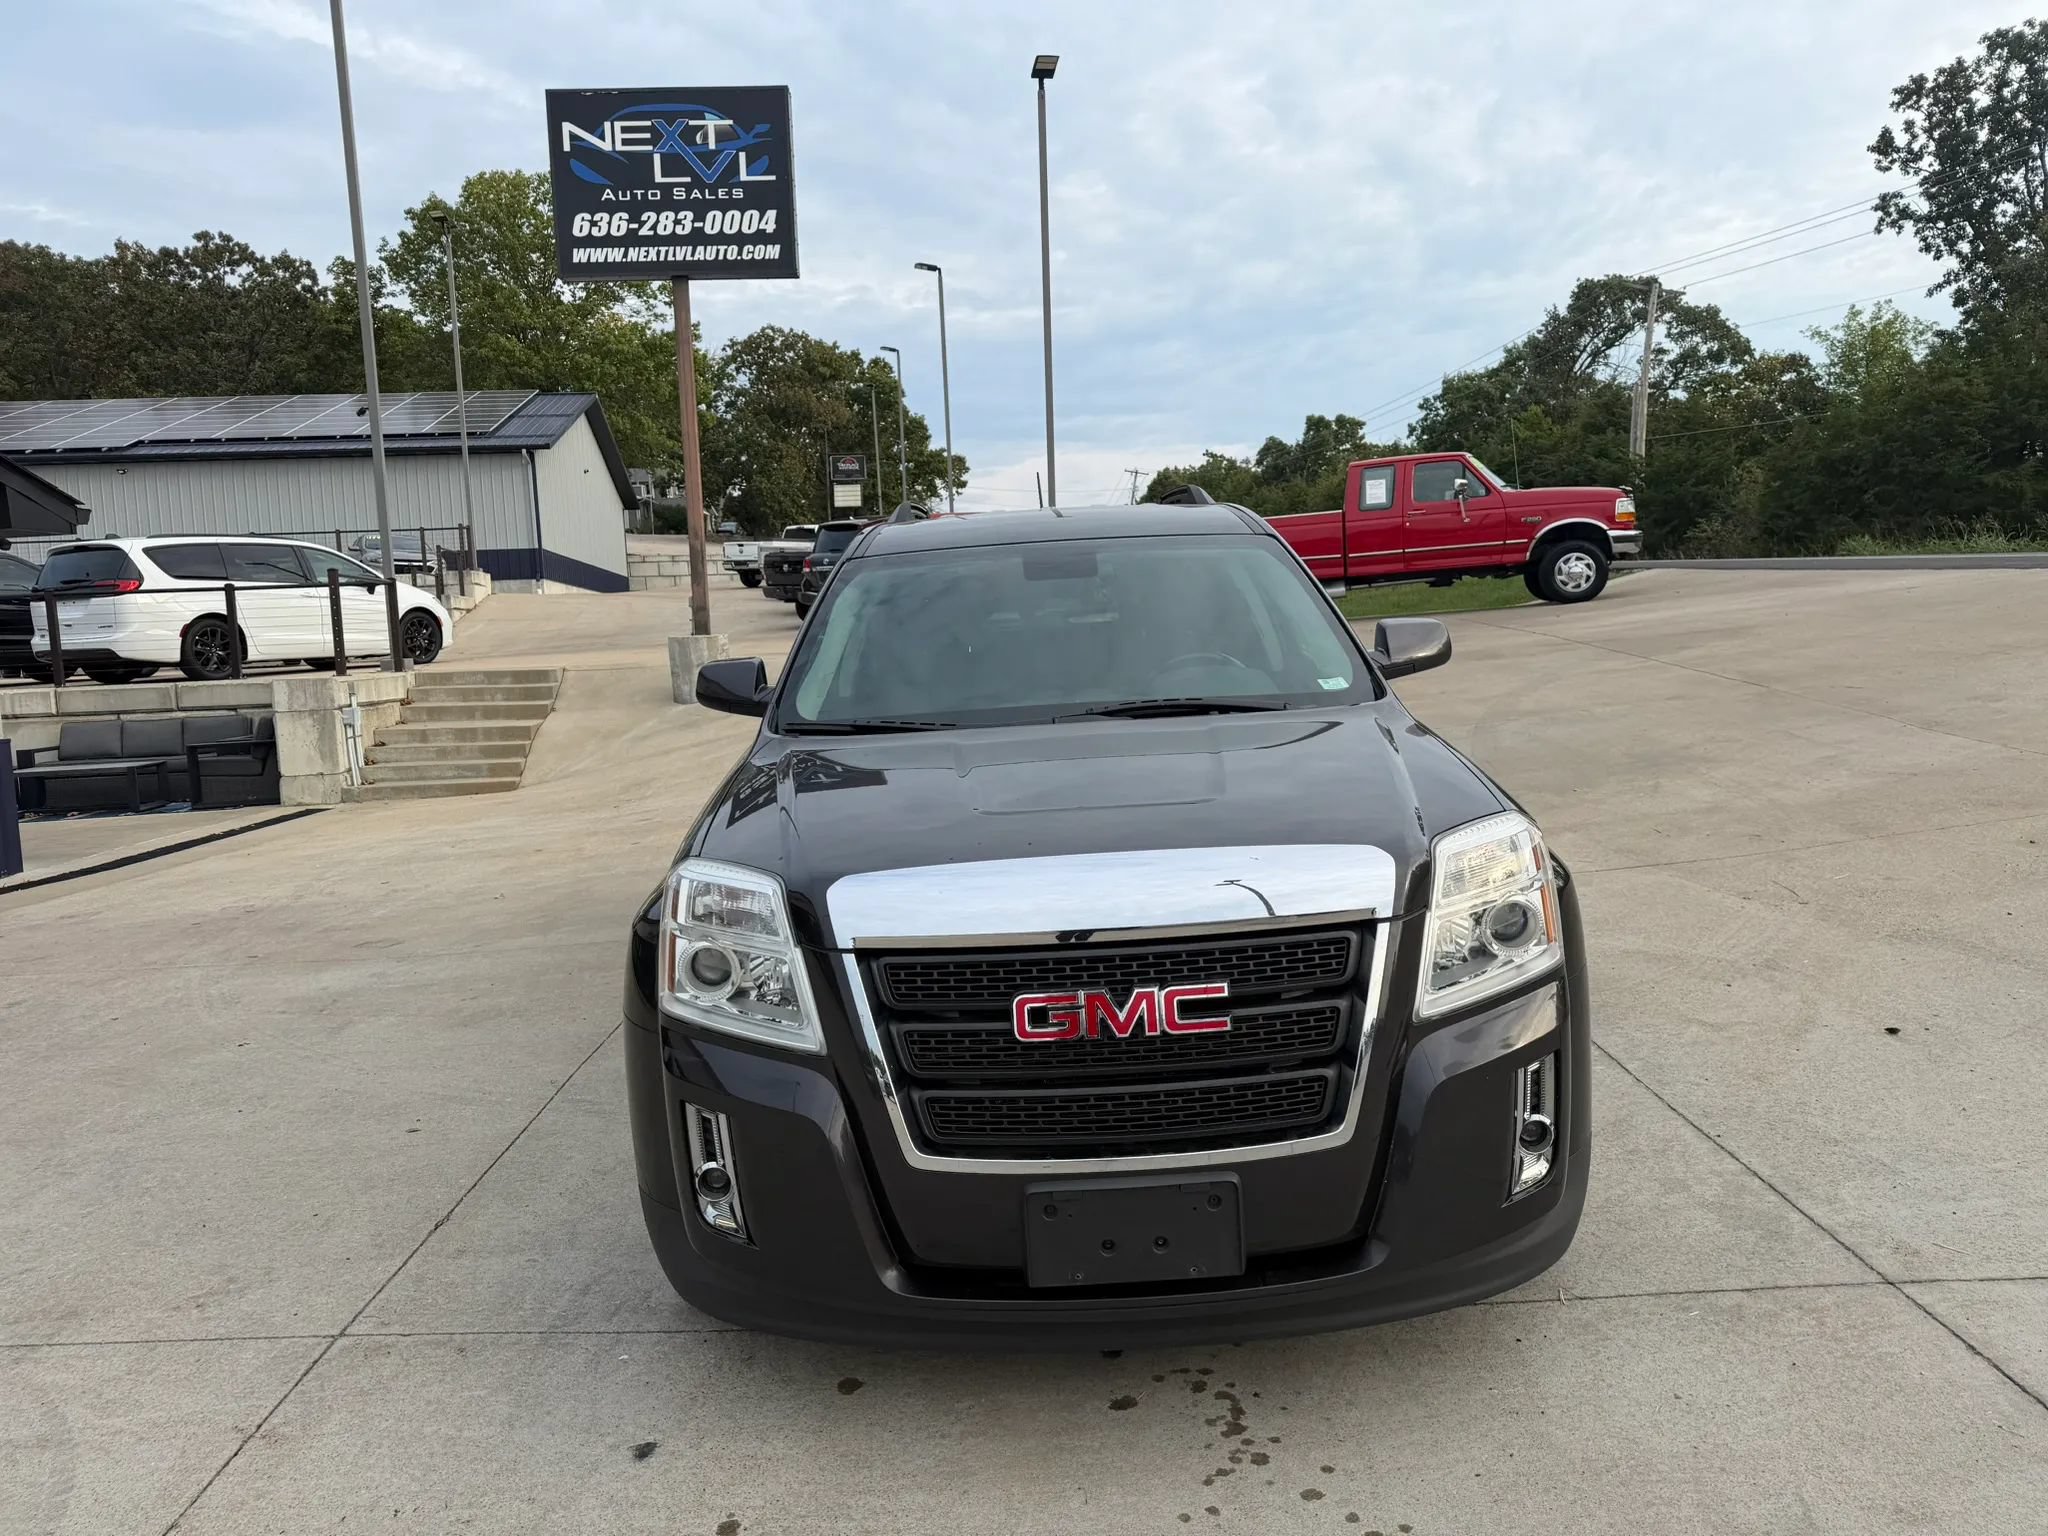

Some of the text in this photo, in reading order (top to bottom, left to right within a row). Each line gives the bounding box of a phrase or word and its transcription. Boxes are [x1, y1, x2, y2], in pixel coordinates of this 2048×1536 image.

[561, 118, 734, 152] NEXT
[653, 150, 777, 184] LVL
[572, 209, 777, 237] 636-283-0004
[572, 244, 781, 264] WWW.NEXTLVLAUTO.COM
[1012, 982, 1233, 1043] GMC
